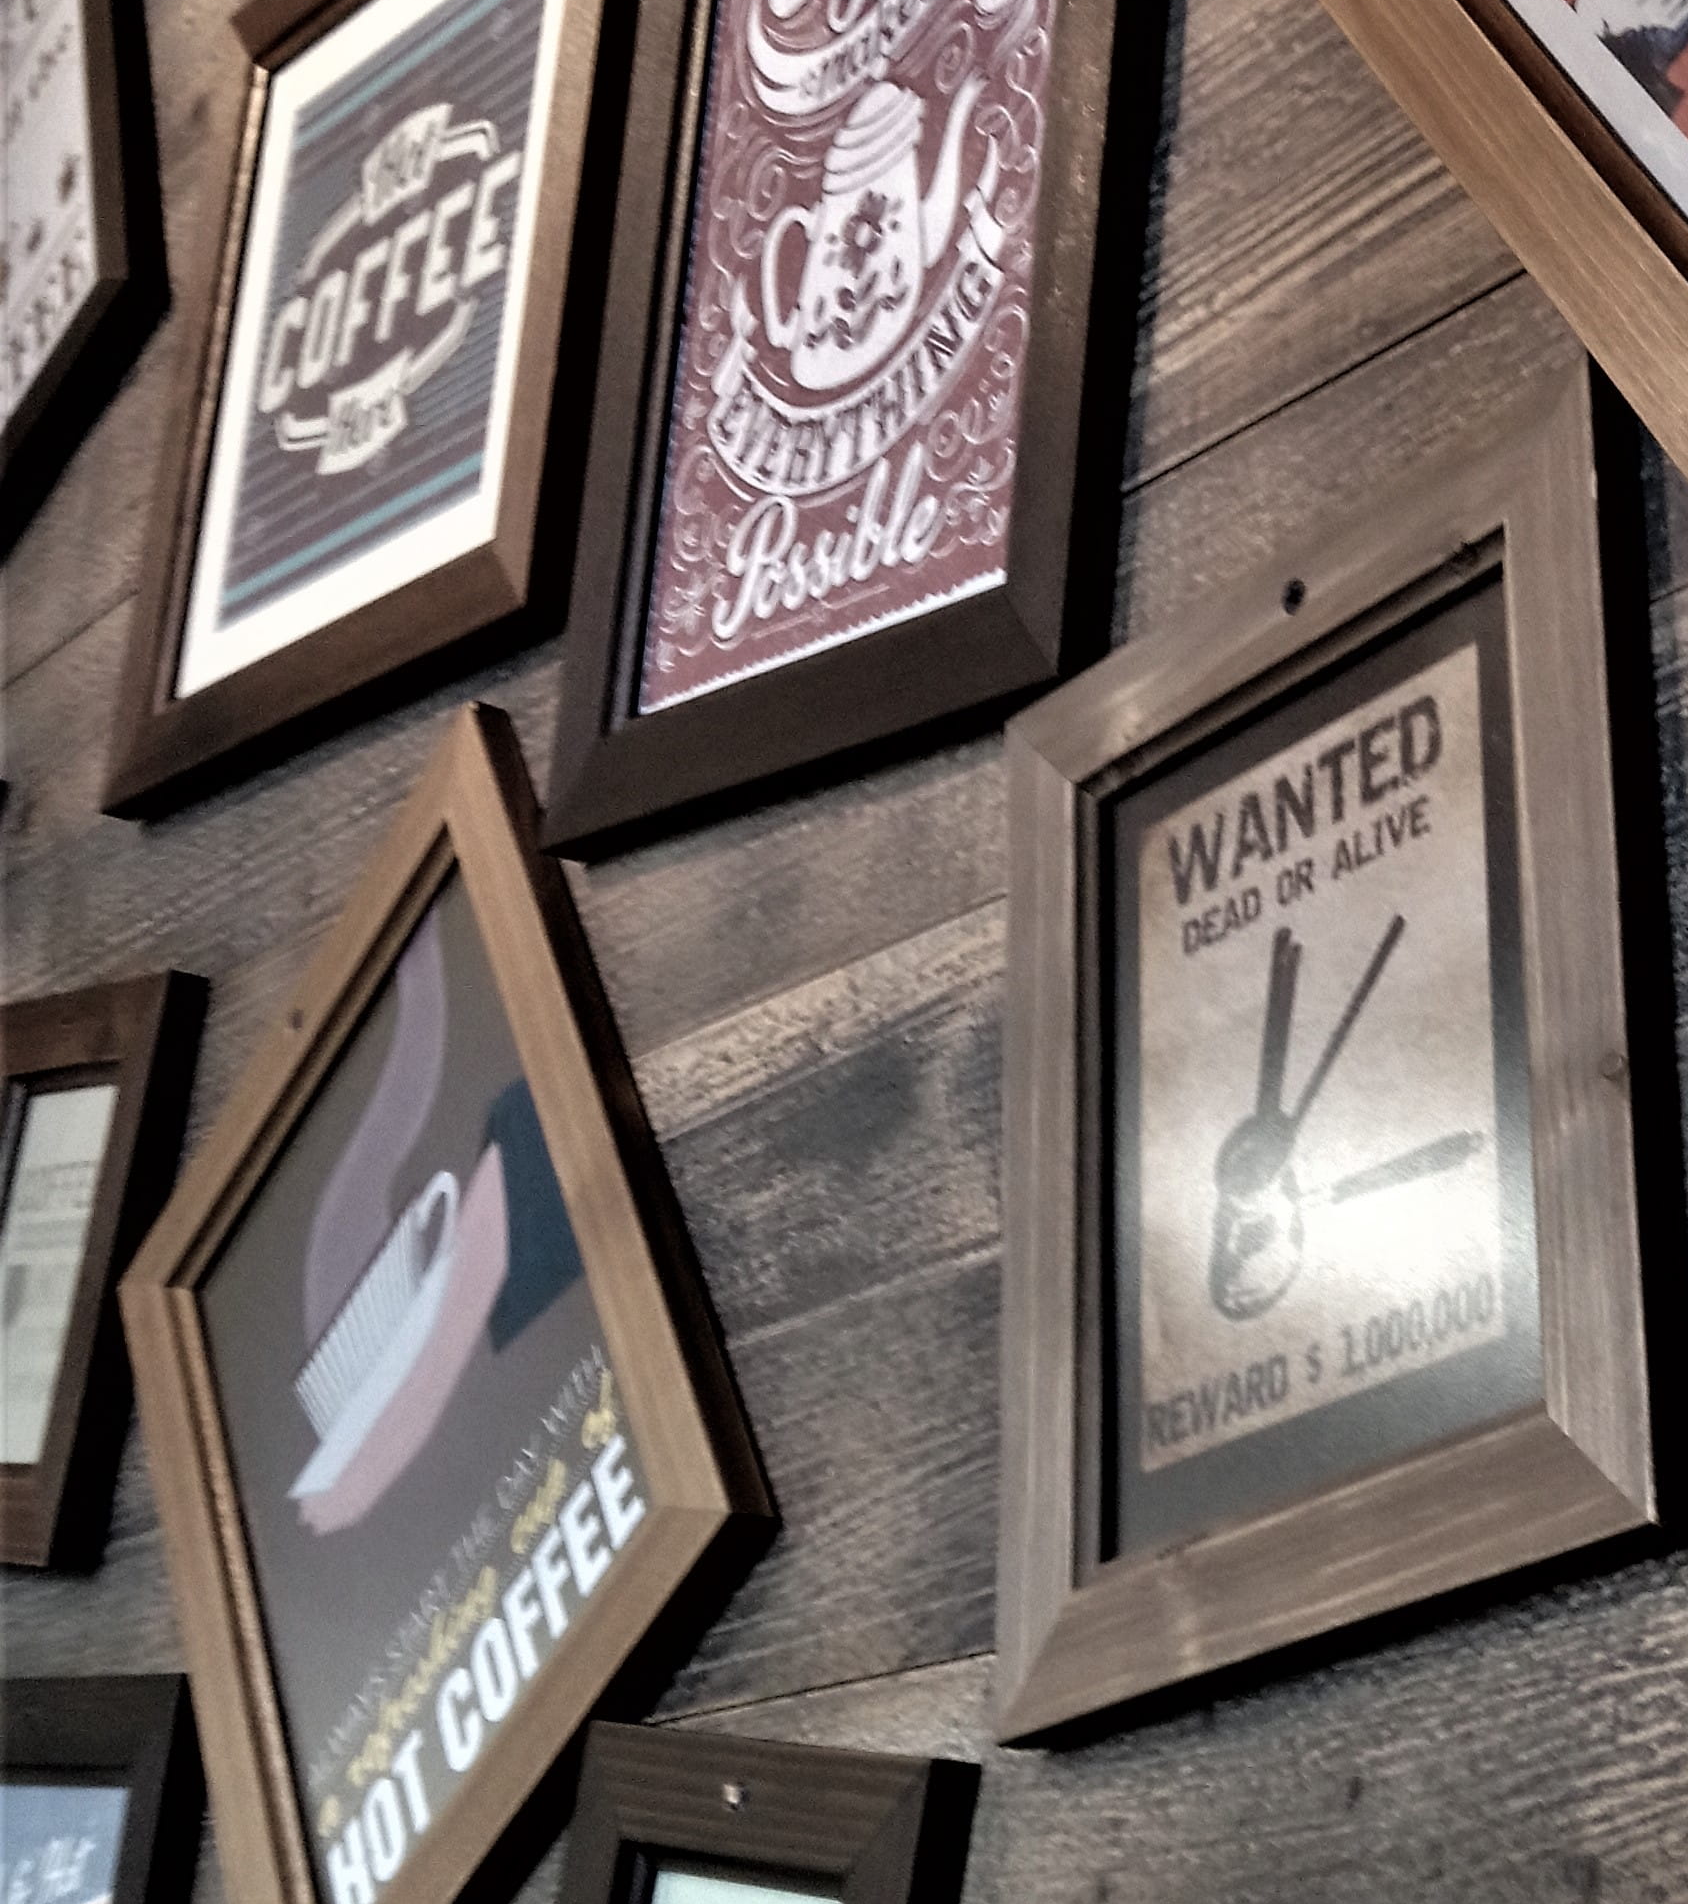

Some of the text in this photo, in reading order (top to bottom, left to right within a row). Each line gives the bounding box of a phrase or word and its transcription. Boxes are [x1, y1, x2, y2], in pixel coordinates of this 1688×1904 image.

[258, 151, 523, 415] COFFEE
[713, 441, 946, 640] Possible
[1166, 694, 1444, 906] WANTED
[1181, 793, 1434, 957] DEAD OR ALIVE
[1146, 1354, 1289, 1450] REWARD
[435, 1434, 646, 1773] COFFEE
